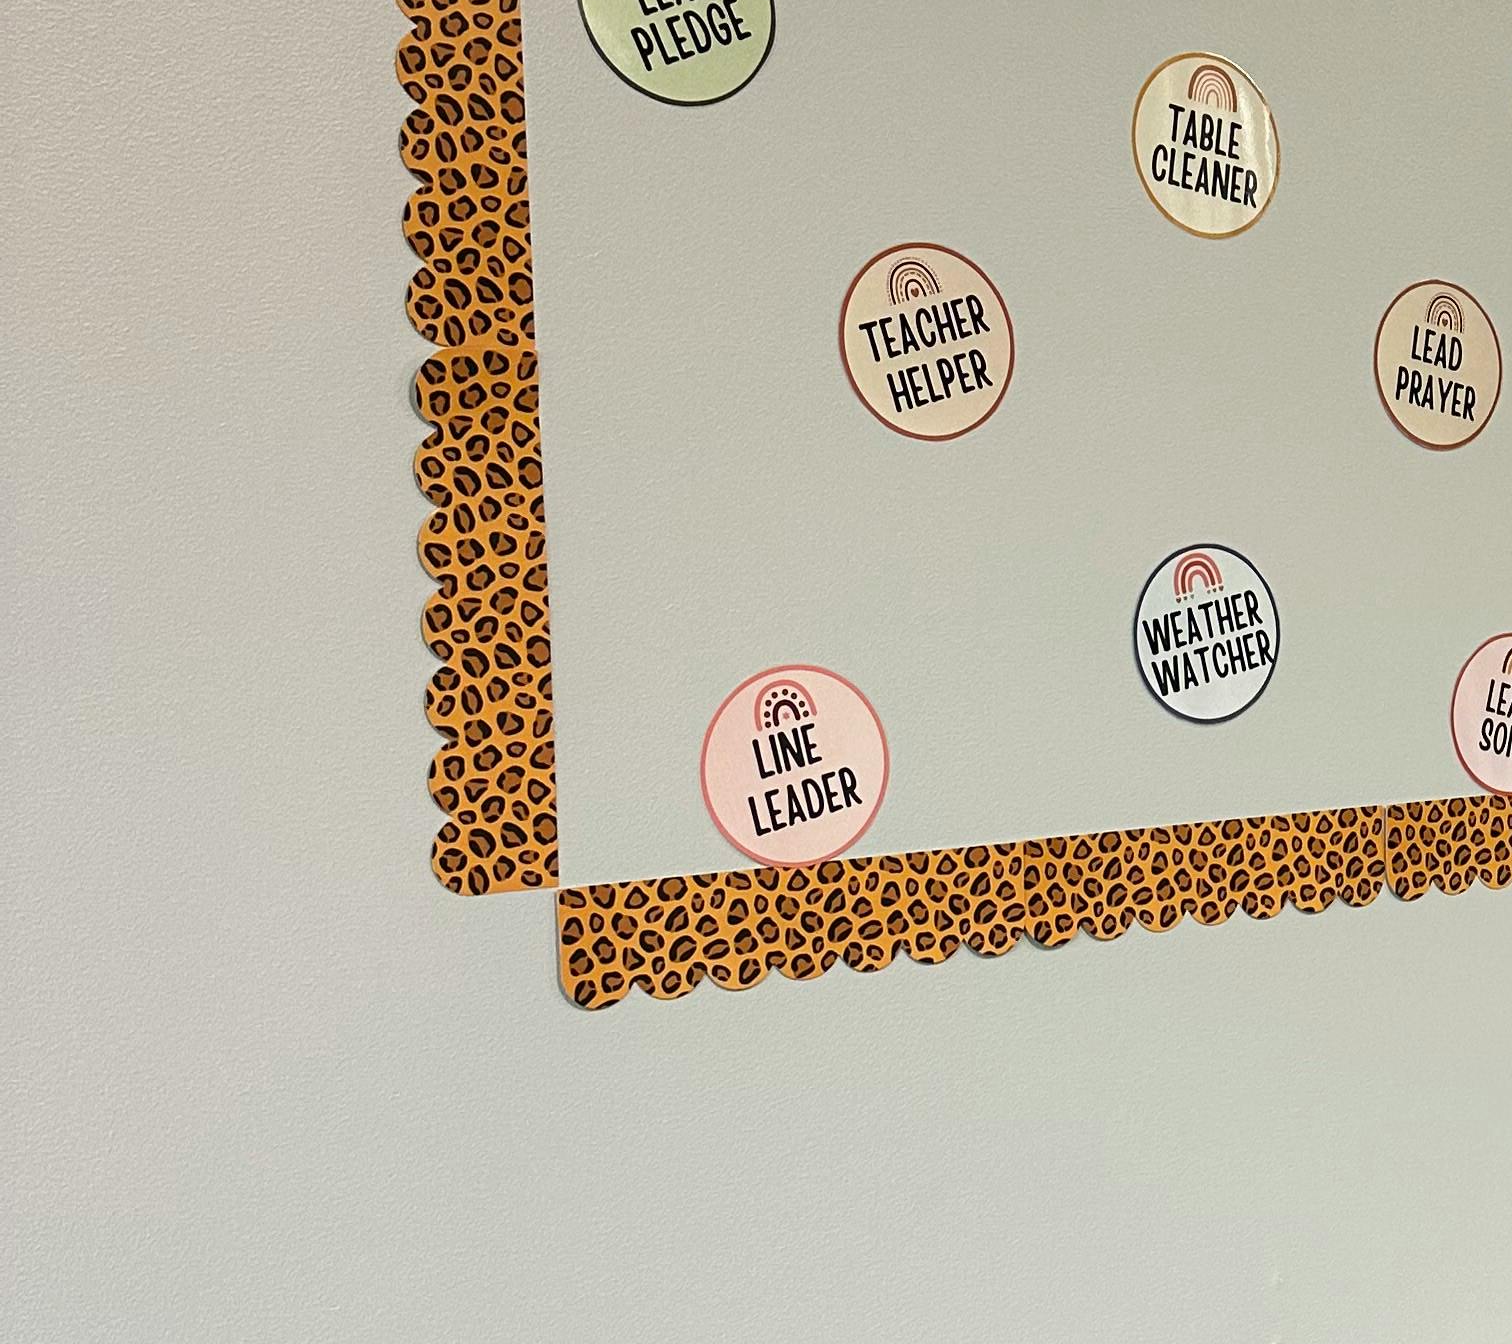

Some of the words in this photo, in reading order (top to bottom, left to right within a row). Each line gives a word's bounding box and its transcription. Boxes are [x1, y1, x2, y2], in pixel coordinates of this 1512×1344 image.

[1169, 104, 1242, 159] TABLE
[1152, 145, 1257, 208] CLEANER
[859, 295, 990, 362] TEACHER
[1412, 325, 1462, 371] LEAD
[887, 350, 993, 412] HELPER
[1396, 366, 1475, 421] PRAYER
[1142, 590, 1263, 655] WEATHER
[1151, 633, 1273, 698] WATCHER
[752, 722, 822, 779] LINE
[748, 767, 862, 836] LEADER
